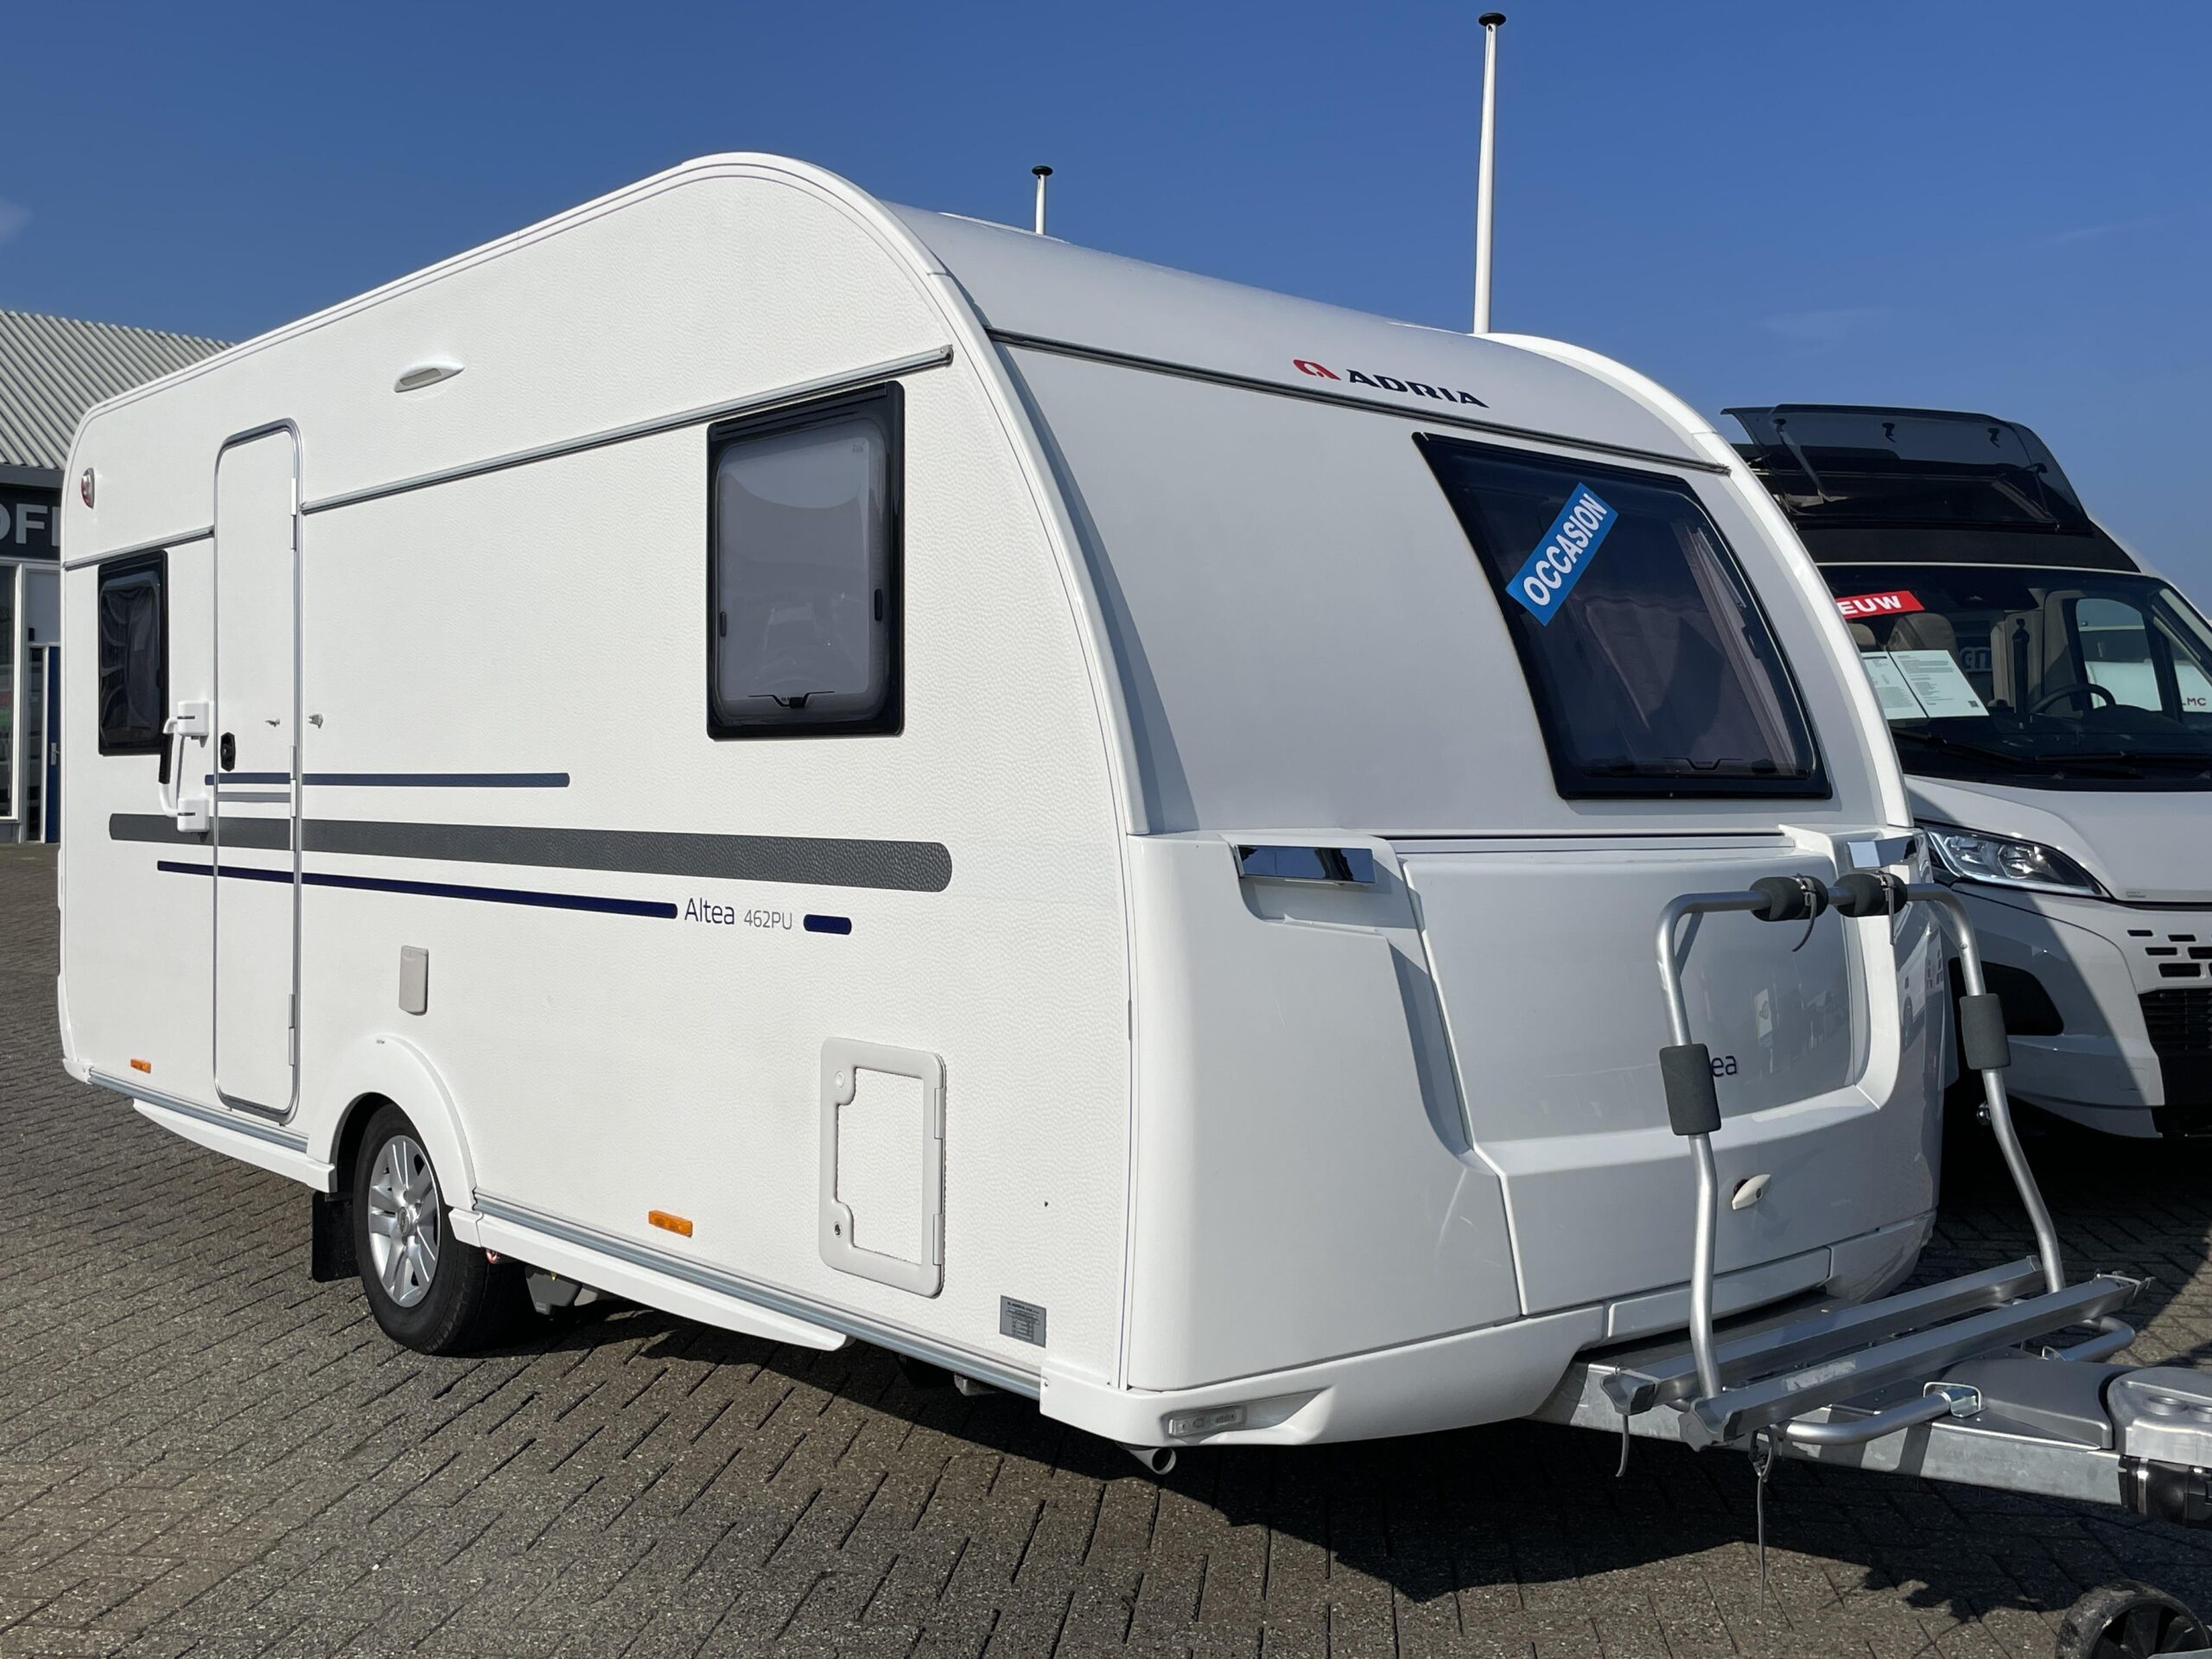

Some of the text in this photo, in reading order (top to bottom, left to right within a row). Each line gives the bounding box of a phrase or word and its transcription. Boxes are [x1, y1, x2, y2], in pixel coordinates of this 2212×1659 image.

[1345, 369, 1490, 408] ADRIA
[1523, 493, 1608, 607] OCCASION
[684, 897, 793, 931] Altea 462PU
[1711, 1055, 1738, 1077] ea
